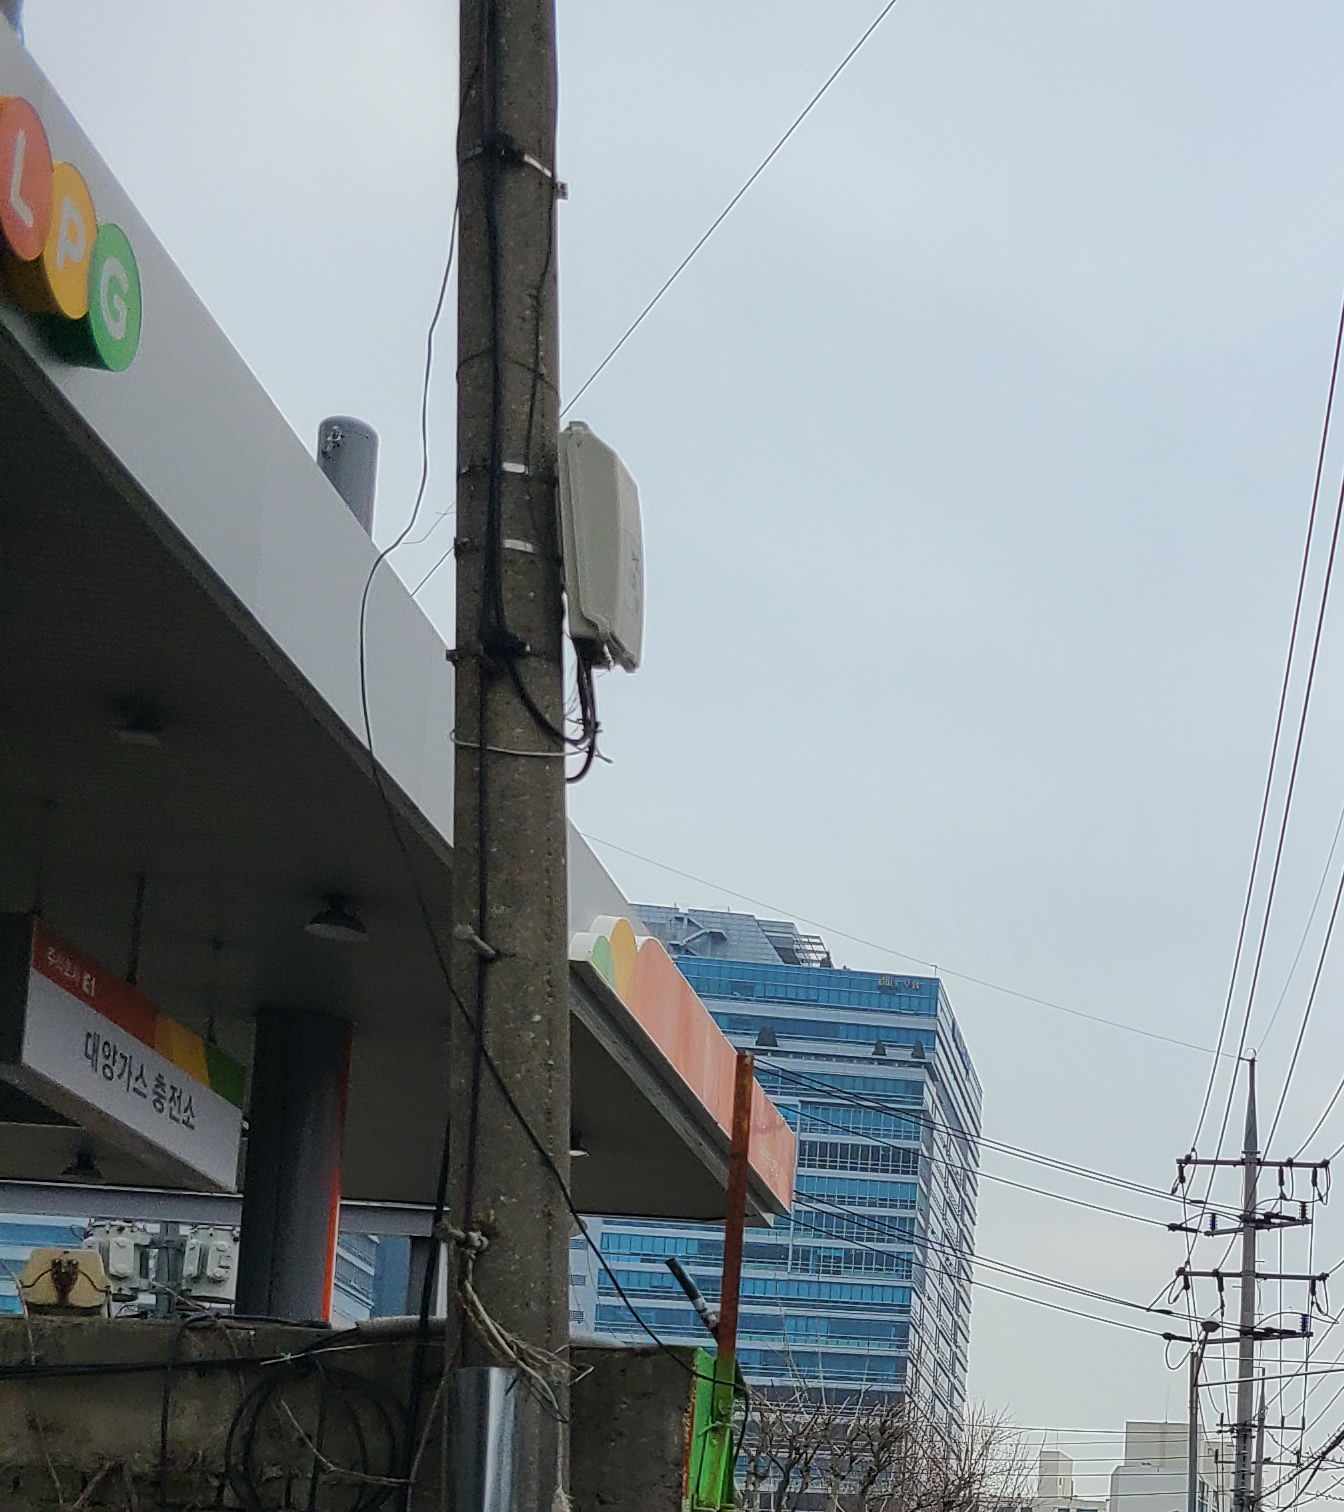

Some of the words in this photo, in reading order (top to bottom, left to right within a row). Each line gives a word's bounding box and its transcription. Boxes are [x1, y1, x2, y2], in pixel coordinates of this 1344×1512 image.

[9, 129, 129, 340] LPG
[84, 1031, 147, 1099] 대양가스
[152, 1074, 195, 1131] 충전소
